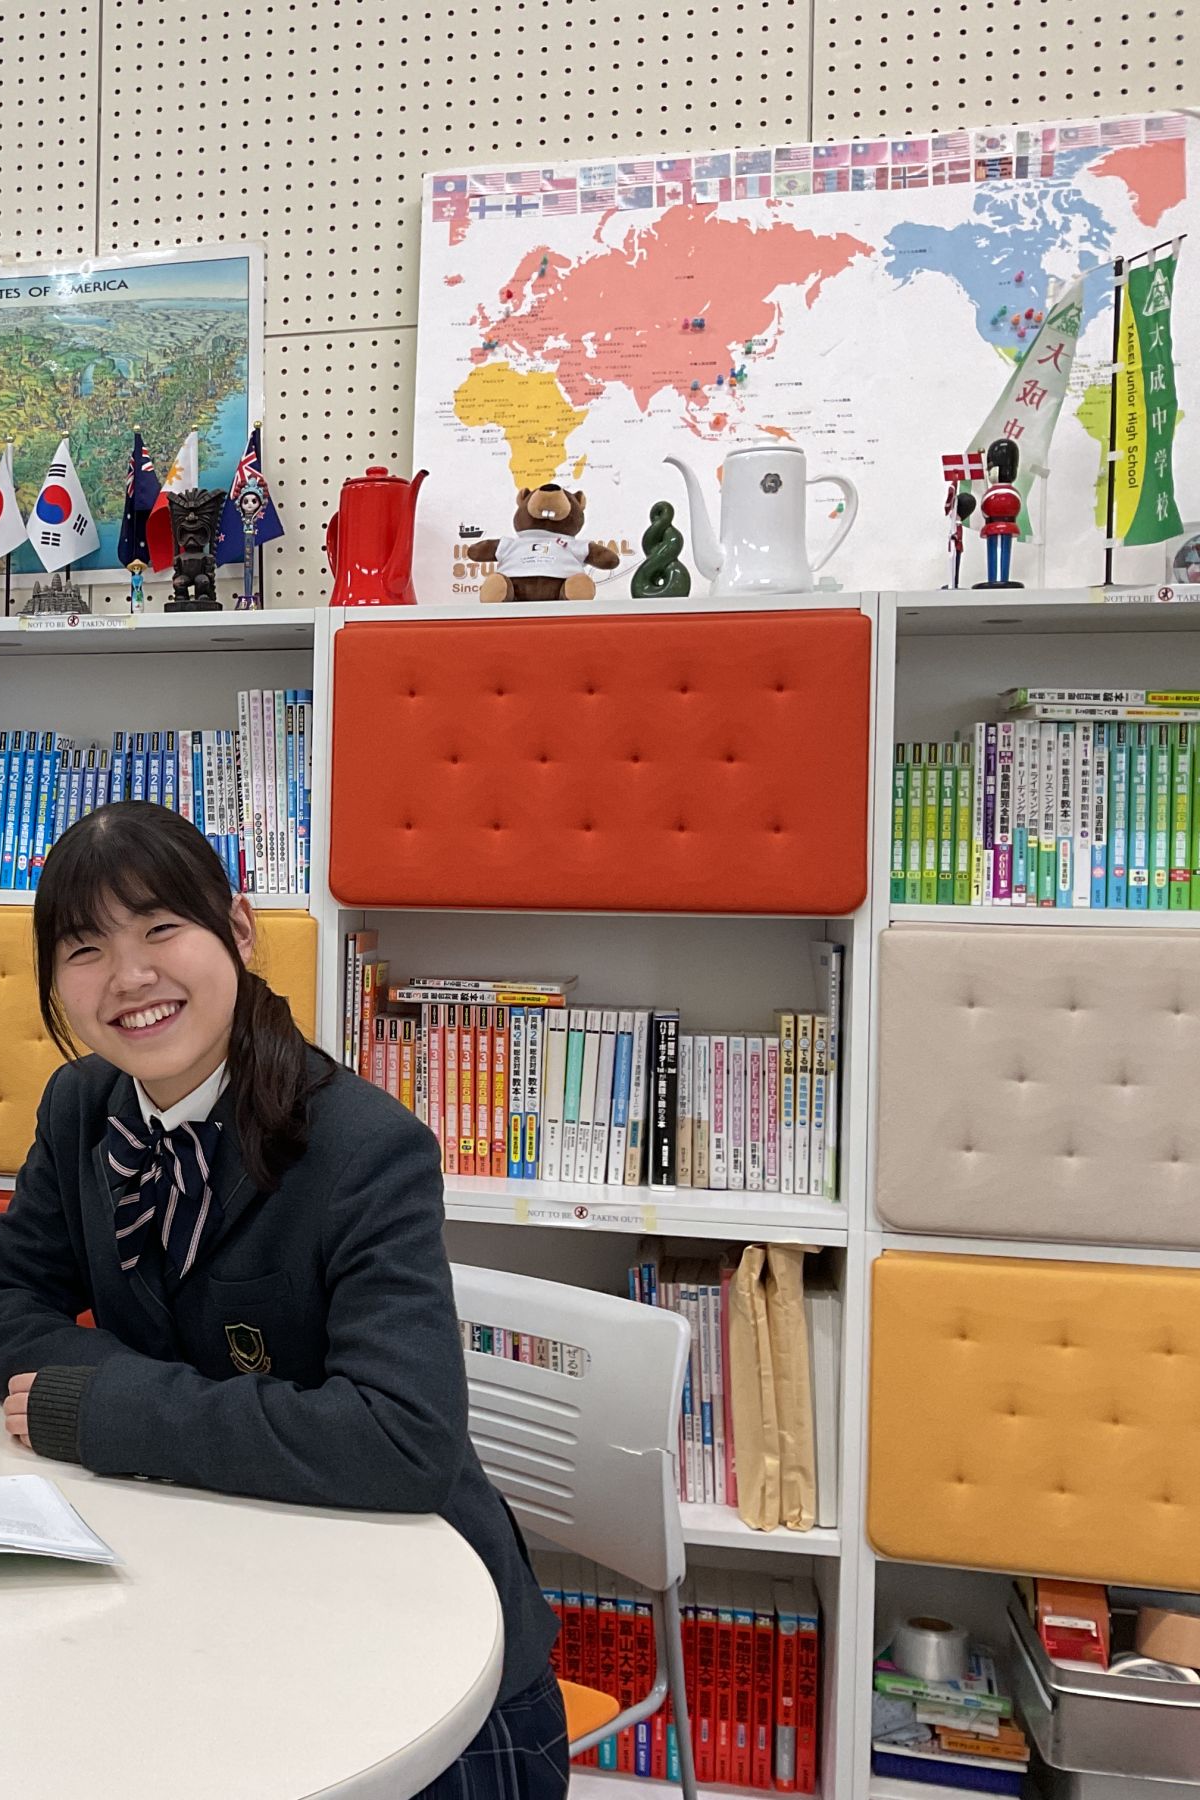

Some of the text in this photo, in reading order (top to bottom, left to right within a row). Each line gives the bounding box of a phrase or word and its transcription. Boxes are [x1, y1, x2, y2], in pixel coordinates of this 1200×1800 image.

[29, 286, 51, 297] OF
[58, 279, 128, 296] MERICA
[1126, 322, 1140, 489] TAISEI Junior High School
[1148, 324, 1172, 522] 大成中学校
[452, 584, 483, 593] Sinc
[591, 1214, 618, 1222] TAKEN
[566, 1612, 582, 1683] 愛知教育大
